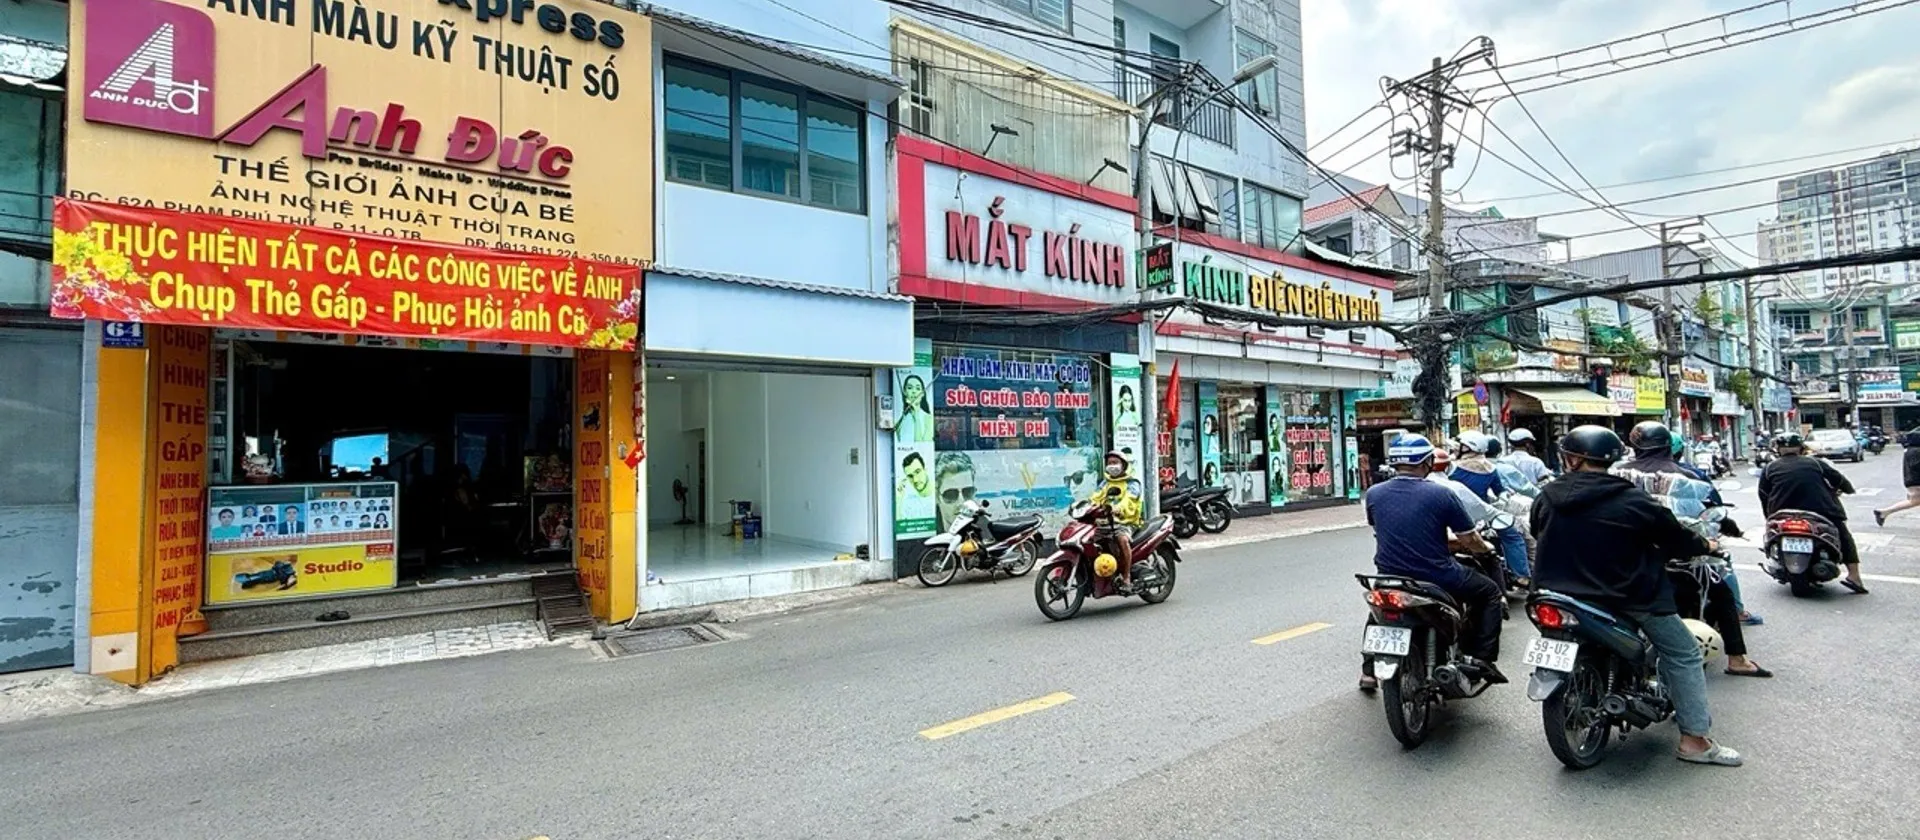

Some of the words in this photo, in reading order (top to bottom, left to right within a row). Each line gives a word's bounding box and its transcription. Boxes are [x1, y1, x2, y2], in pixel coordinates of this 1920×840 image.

[413, 20, 458, 63] KỸ
[473, 35, 572, 94] THUẬT
[582, 55, 620, 101] SỐ
[214, 63, 422, 160] Anh
[445, 116, 573, 178] Đức
[329, 154, 353, 165] Pro
[213, 154, 290, 184] THẾ
[306, 169, 377, 196] GIỚI
[389, 175, 458, 207] ẢNH
[468, 192, 530, 218] CỦA
[539, 203, 575, 223] BÉ
[210, 180, 270, 204] ẢNH
[363, 205, 443, 229] THUẬT
[450, 216, 500, 234] THỜI
[507, 225, 575, 244] TRANG
[945, 196, 1033, 273] MẮT
[1044, 222, 1125, 290] KÍNH
[90, 220, 178, 266] THỰC
[187, 228, 258, 273] HIỆN
[265, 229, 319, 272] TẤT
[325, 239, 361, 276] CẢ
[368, 243, 420, 283] CÁC
[426, 254, 491, 290] CÔNG
[496, 261, 546, 299] VIỆC
[550, 261, 578, 297] VỀ
[582, 265, 623, 301] ẢNH
[1148, 266, 1173, 285] KÍNH
[1182, 255, 1245, 306] KÍNH
[1250, 270, 1302, 316] ĐIỆN
[150, 271, 236, 321] Chụp
[245, 278, 302, 316] Thẻ
[310, 281, 367, 328] Gấp
[393, 290, 457, 335] Phục
[464, 292, 503, 330] Hồi
[510, 298, 551, 333] ảnh
[106, 322, 142, 337] 64
[162, 325, 207, 355] CHỤP
[163, 359, 206, 389] HÌNH
[946, 384, 977, 407] SỬA
[980, 386, 1019, 408] CHỮA
[1054, 387, 1090, 408] HÀNH
[161, 399, 206, 425] THẺ
[979, 414, 1017, 438] MIỄN
[1024, 417, 1050, 437] PHÍ
[162, 433, 203, 463] GẤP
[304, 559, 364, 575] Studio
[1534, 639, 1570, 656] 59-U2
